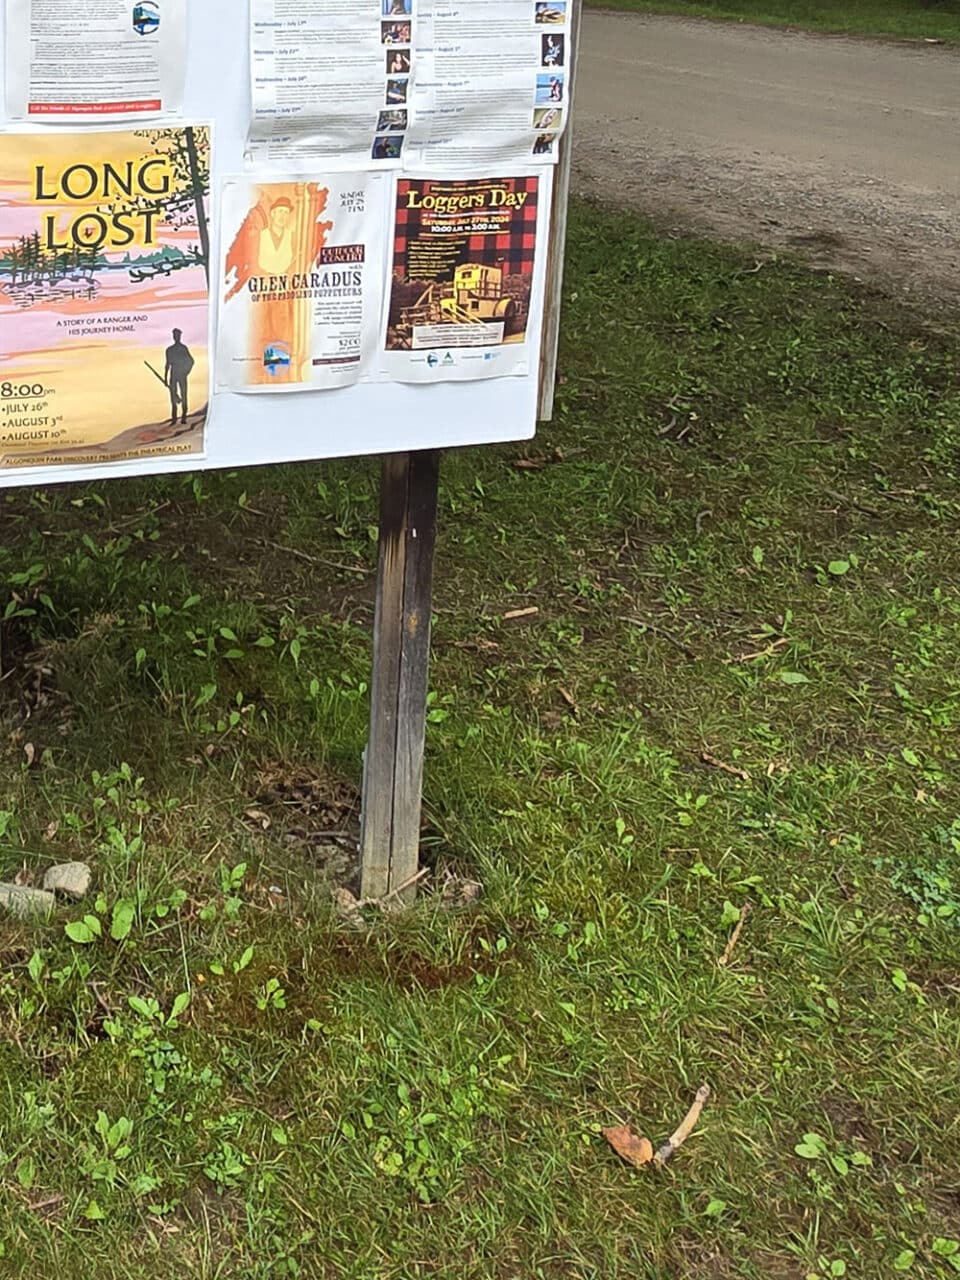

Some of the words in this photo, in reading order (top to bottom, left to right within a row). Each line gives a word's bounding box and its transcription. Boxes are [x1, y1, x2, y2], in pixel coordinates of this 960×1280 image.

[35, 159, 170, 200] LONG
[406, 191, 485, 213] Loggers
[489, 189, 528, 210] Day
[47, 211, 161, 250] LOST
[248, 276, 288, 293] GLEN
[292, 271, 361, 289] CARADUS
[314, 288, 362, 298] PUPPETEERS
[64, 319, 84, 327] STORY
[86, 318, 96, 326] OF
[103, 315, 131, 324] RANGER
[69, 328, 80, 336] HIS
[81, 327, 112, 336] JOURNEY
[6, 403, 29, 415] JULY
[31, 402, 48, 411] 26th
[7, 417, 49, 428] AUGUST
[51, 415, 63, 427] 3rd
[7, 431, 49, 441] AUGUST
[51, 429, 67, 438] 10th
